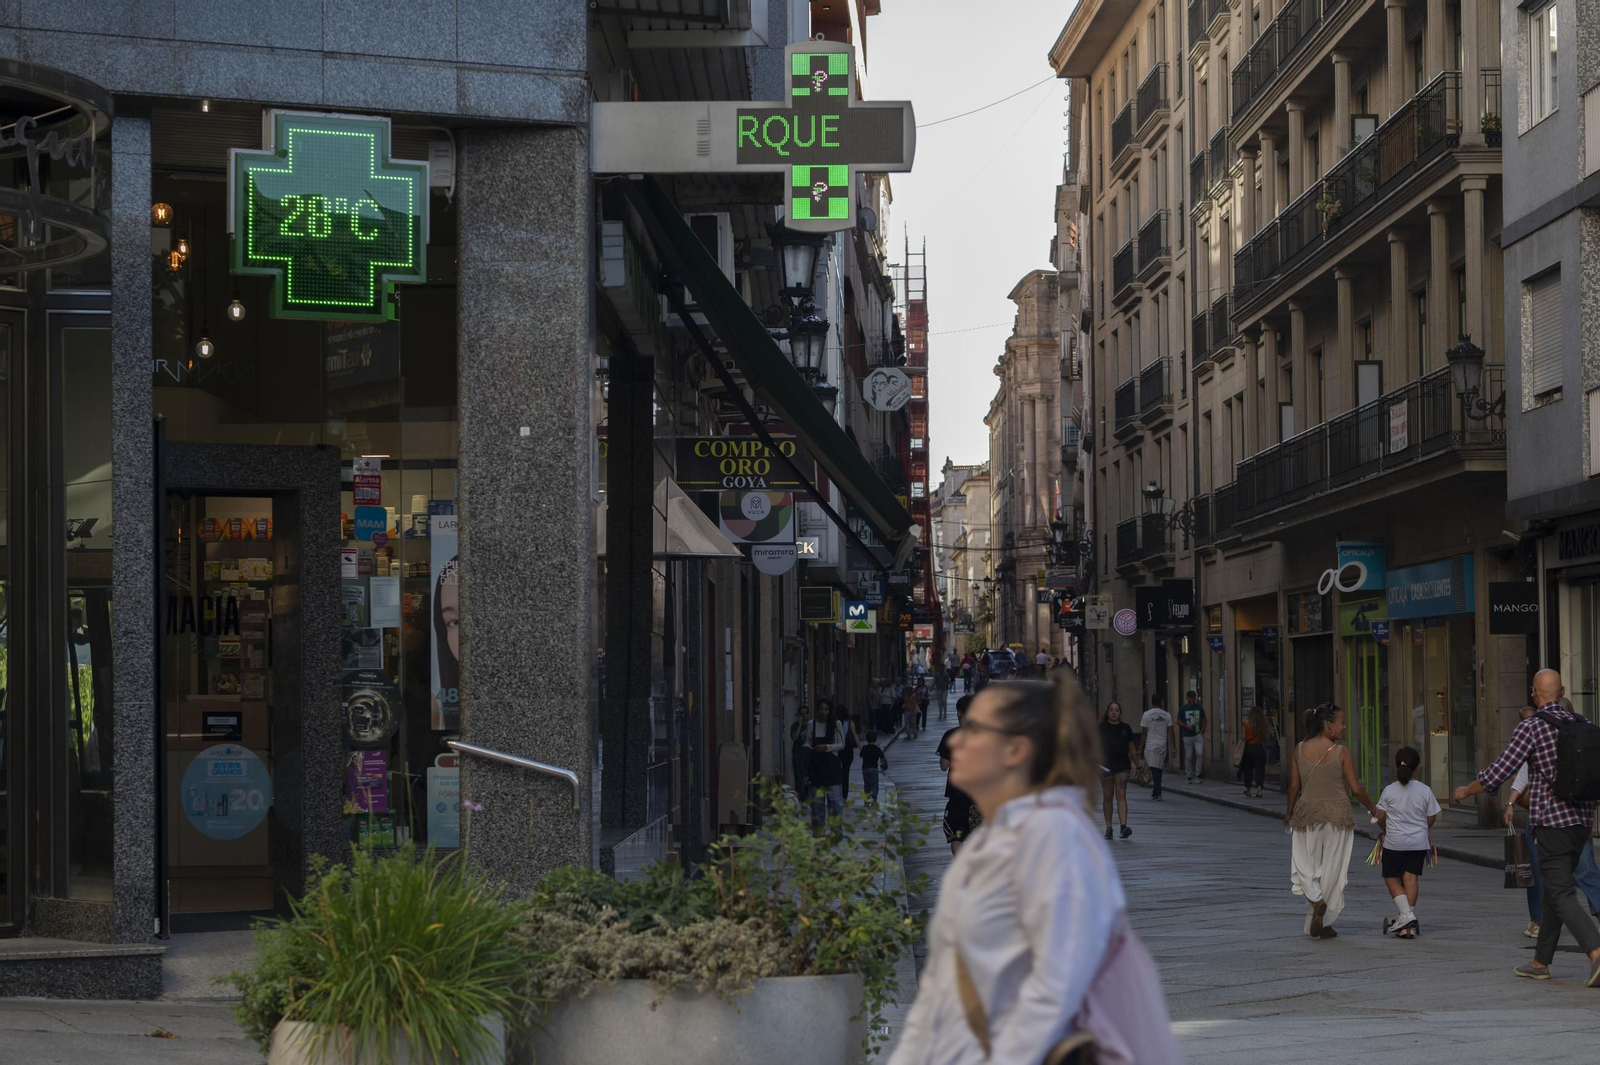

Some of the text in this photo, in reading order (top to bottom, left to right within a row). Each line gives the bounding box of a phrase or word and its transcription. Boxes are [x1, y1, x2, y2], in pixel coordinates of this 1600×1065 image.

[738, 114, 840, 156] RQUE
[719, 458, 771, 476] ORO
[355, 476, 380, 484] Alarma
[722, 476, 767, 489] GOYA
[356, 519, 385, 529] MAM
[1493, 603, 1539, 613] MANGO
[436, 687, 459, 703] 48
[231, 789, 264, 811] 20
